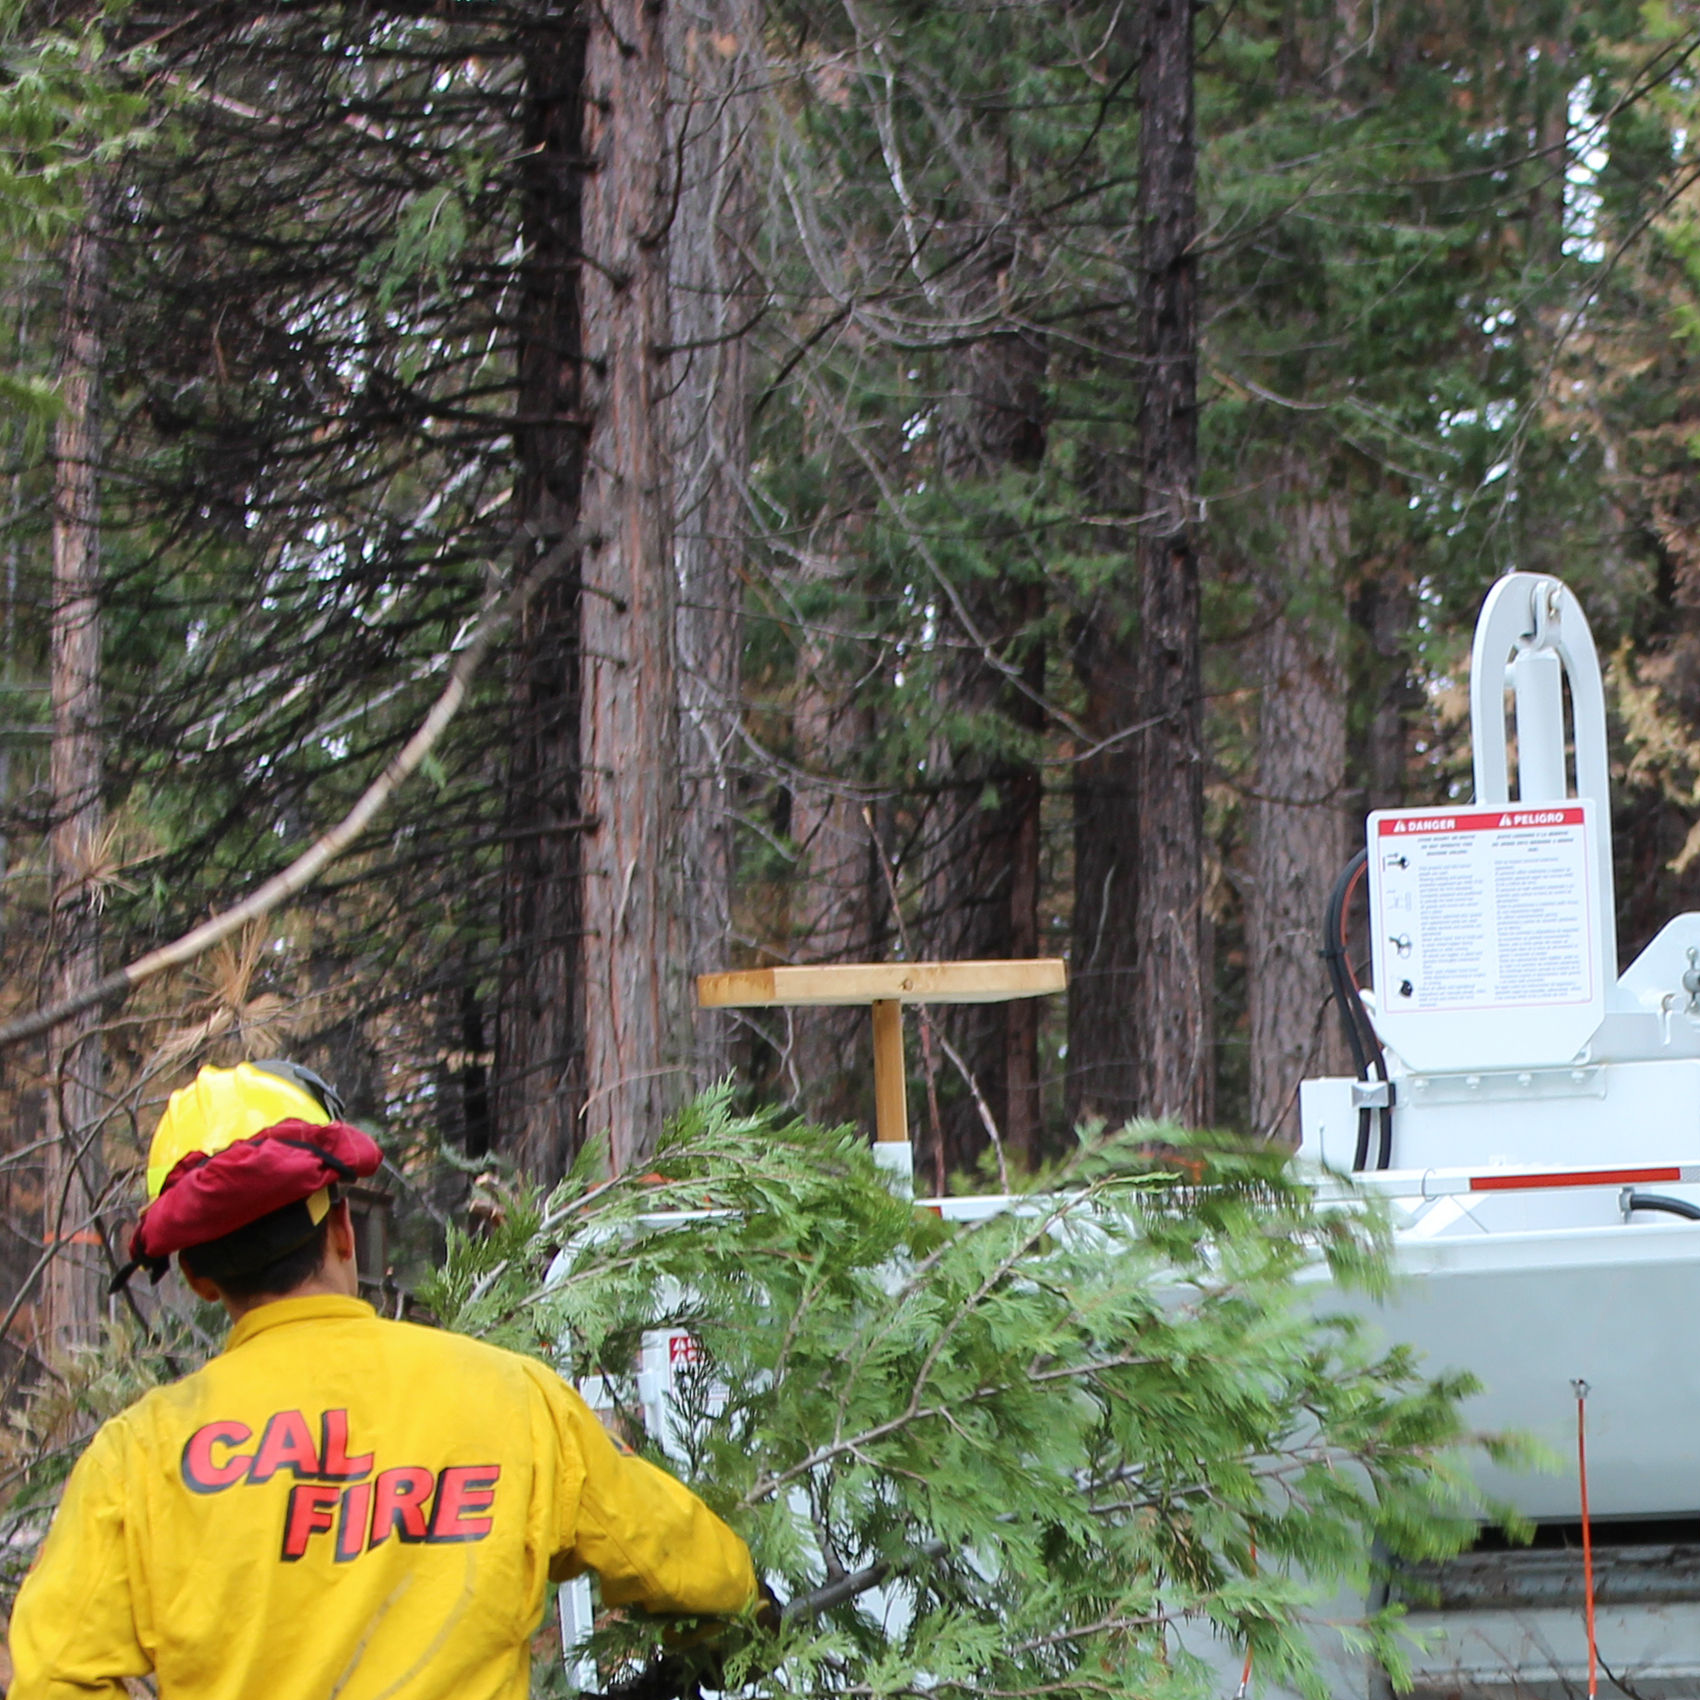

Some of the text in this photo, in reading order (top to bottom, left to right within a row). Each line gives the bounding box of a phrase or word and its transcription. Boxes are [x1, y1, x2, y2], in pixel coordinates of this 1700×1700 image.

[1408, 818, 1456, 832] DANGER
[1513, 811, 1565, 826] PELIGRO
[180, 1408, 375, 1495] CAL
[280, 1463, 501, 1563] FIRE
